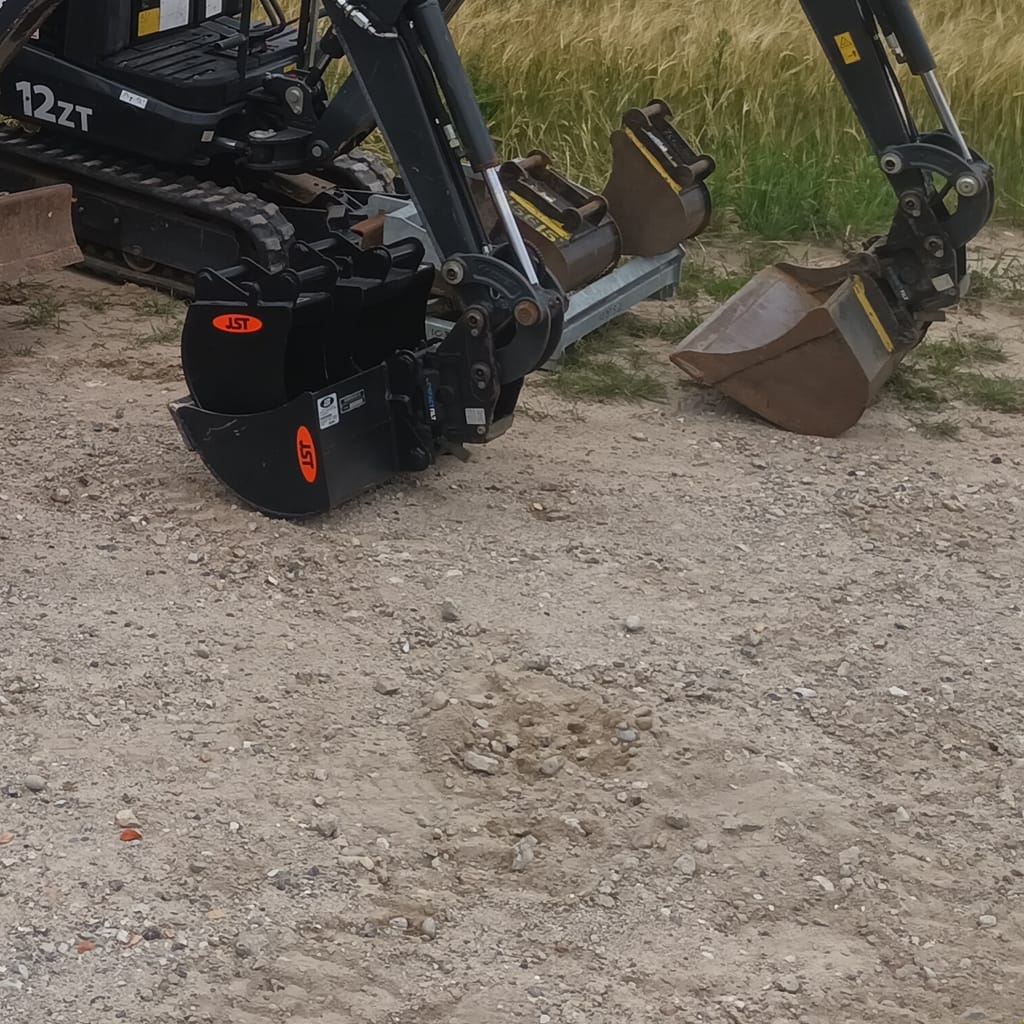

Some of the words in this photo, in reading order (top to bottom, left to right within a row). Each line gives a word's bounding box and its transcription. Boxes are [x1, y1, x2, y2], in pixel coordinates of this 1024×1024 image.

[16, 81, 93, 132] 12ZT
[225, 317, 250, 330] JST
[299, 440, 314, 469] JST
